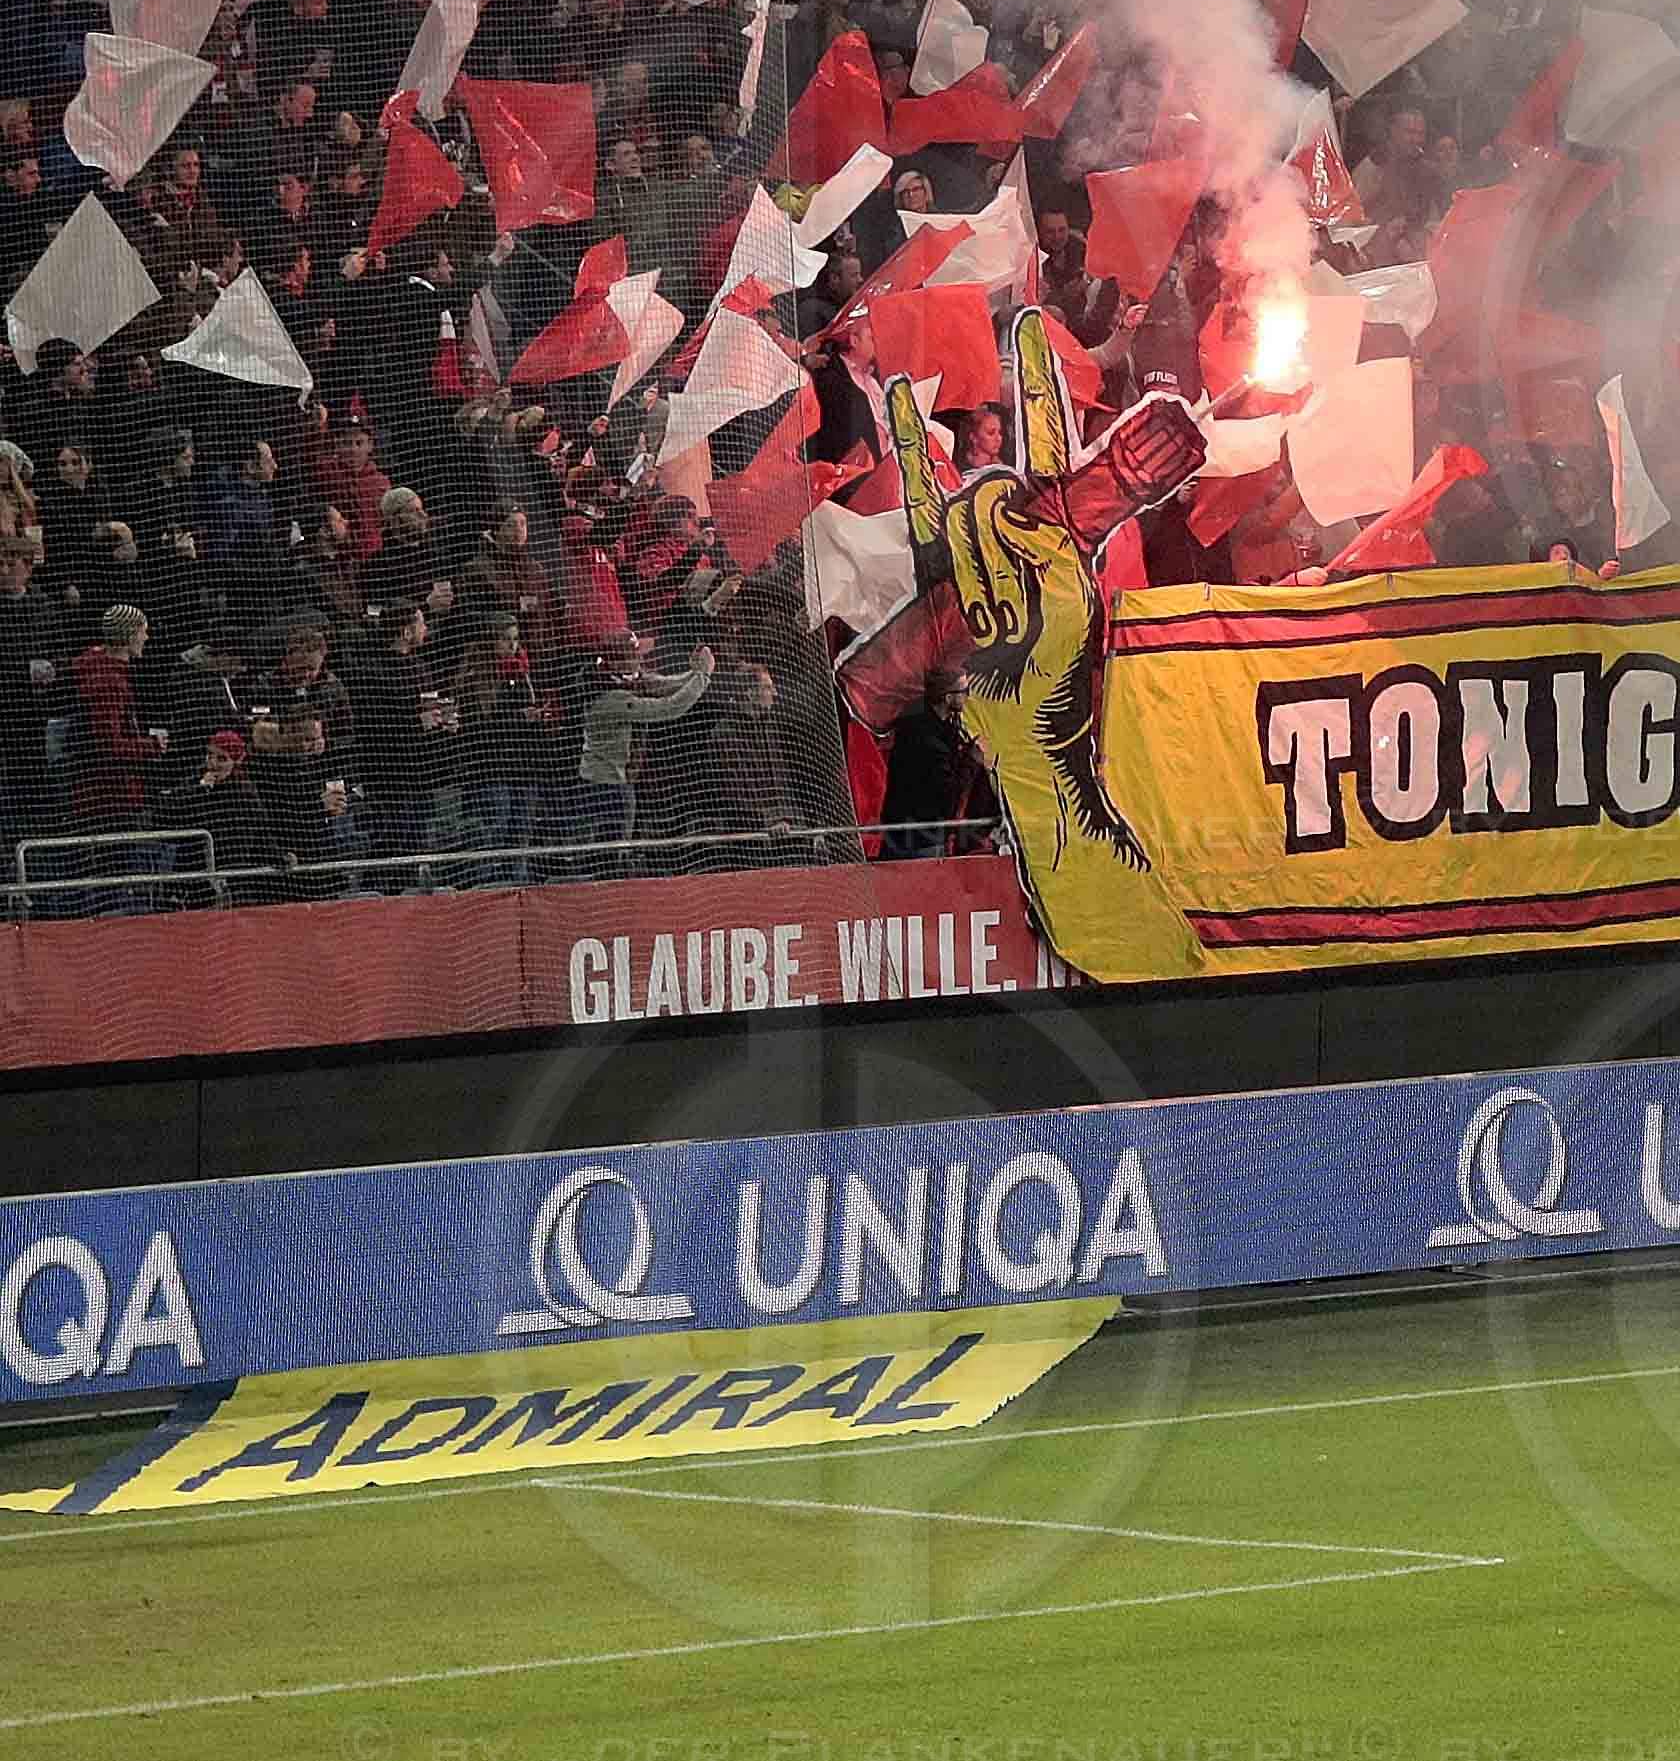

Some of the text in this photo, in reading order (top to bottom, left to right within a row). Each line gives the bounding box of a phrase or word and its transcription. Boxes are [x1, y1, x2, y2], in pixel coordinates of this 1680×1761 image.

[570, 924, 818, 1024] GLAUBE.
[837, 911, 1017, 1004] WILLE.
[736, 1148, 1168, 1313] UNIQA
[176, 1332, 984, 1492] ADMIRAL
